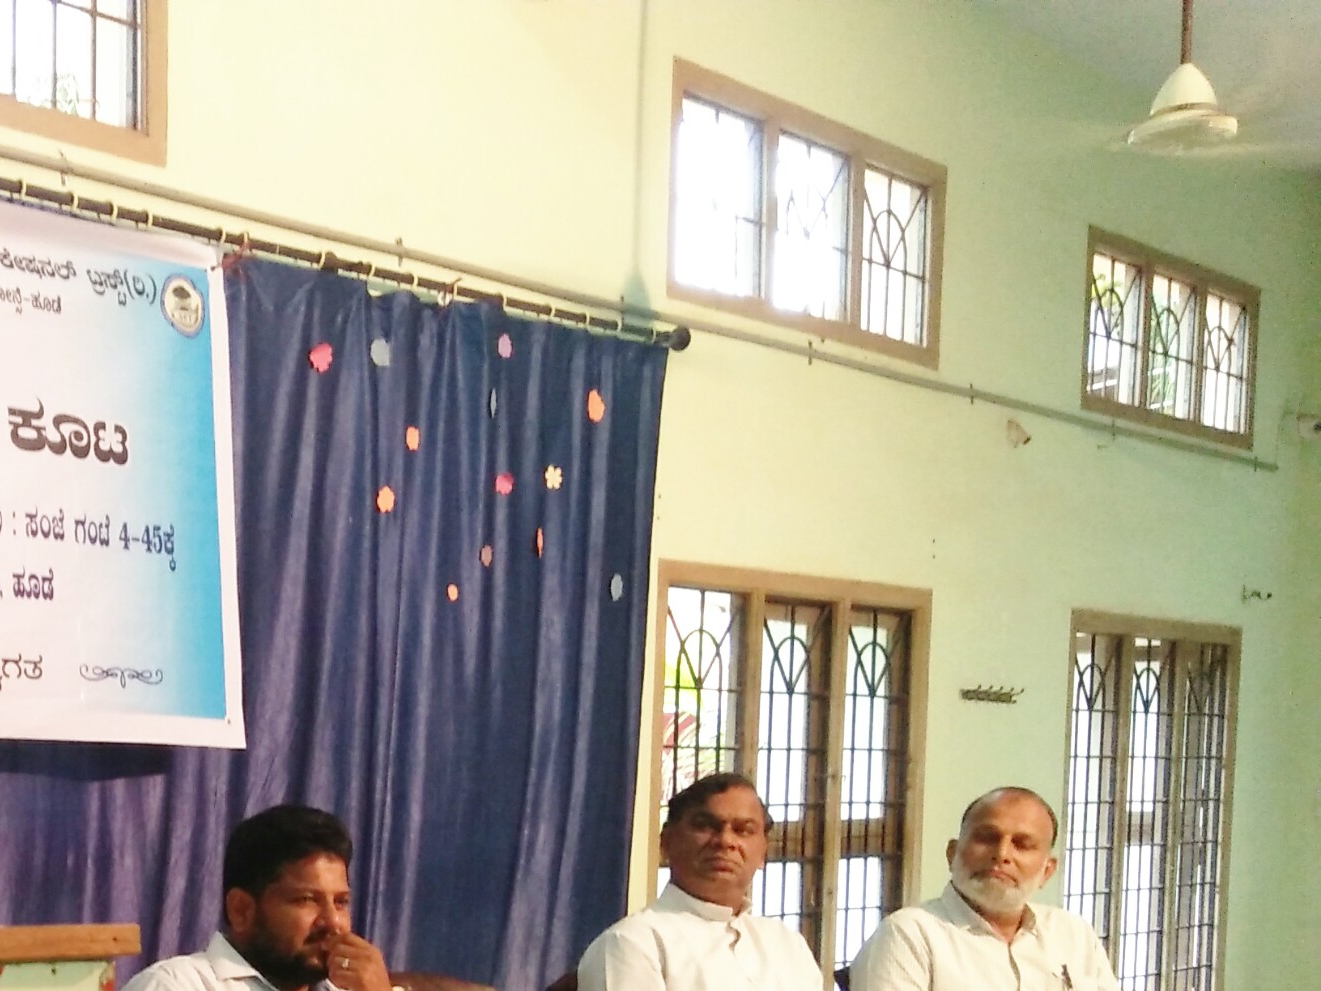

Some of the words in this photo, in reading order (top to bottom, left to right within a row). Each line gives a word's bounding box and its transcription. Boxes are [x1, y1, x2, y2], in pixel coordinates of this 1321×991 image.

[8, 397, 129, 466] ಕೂಟ
[25, 507, 65, 541] ಸಂಜೆ
[74, 514, 111, 547] ಗಂಟೆ
[12, 565, 54, 600] ಹೂಡೆ
